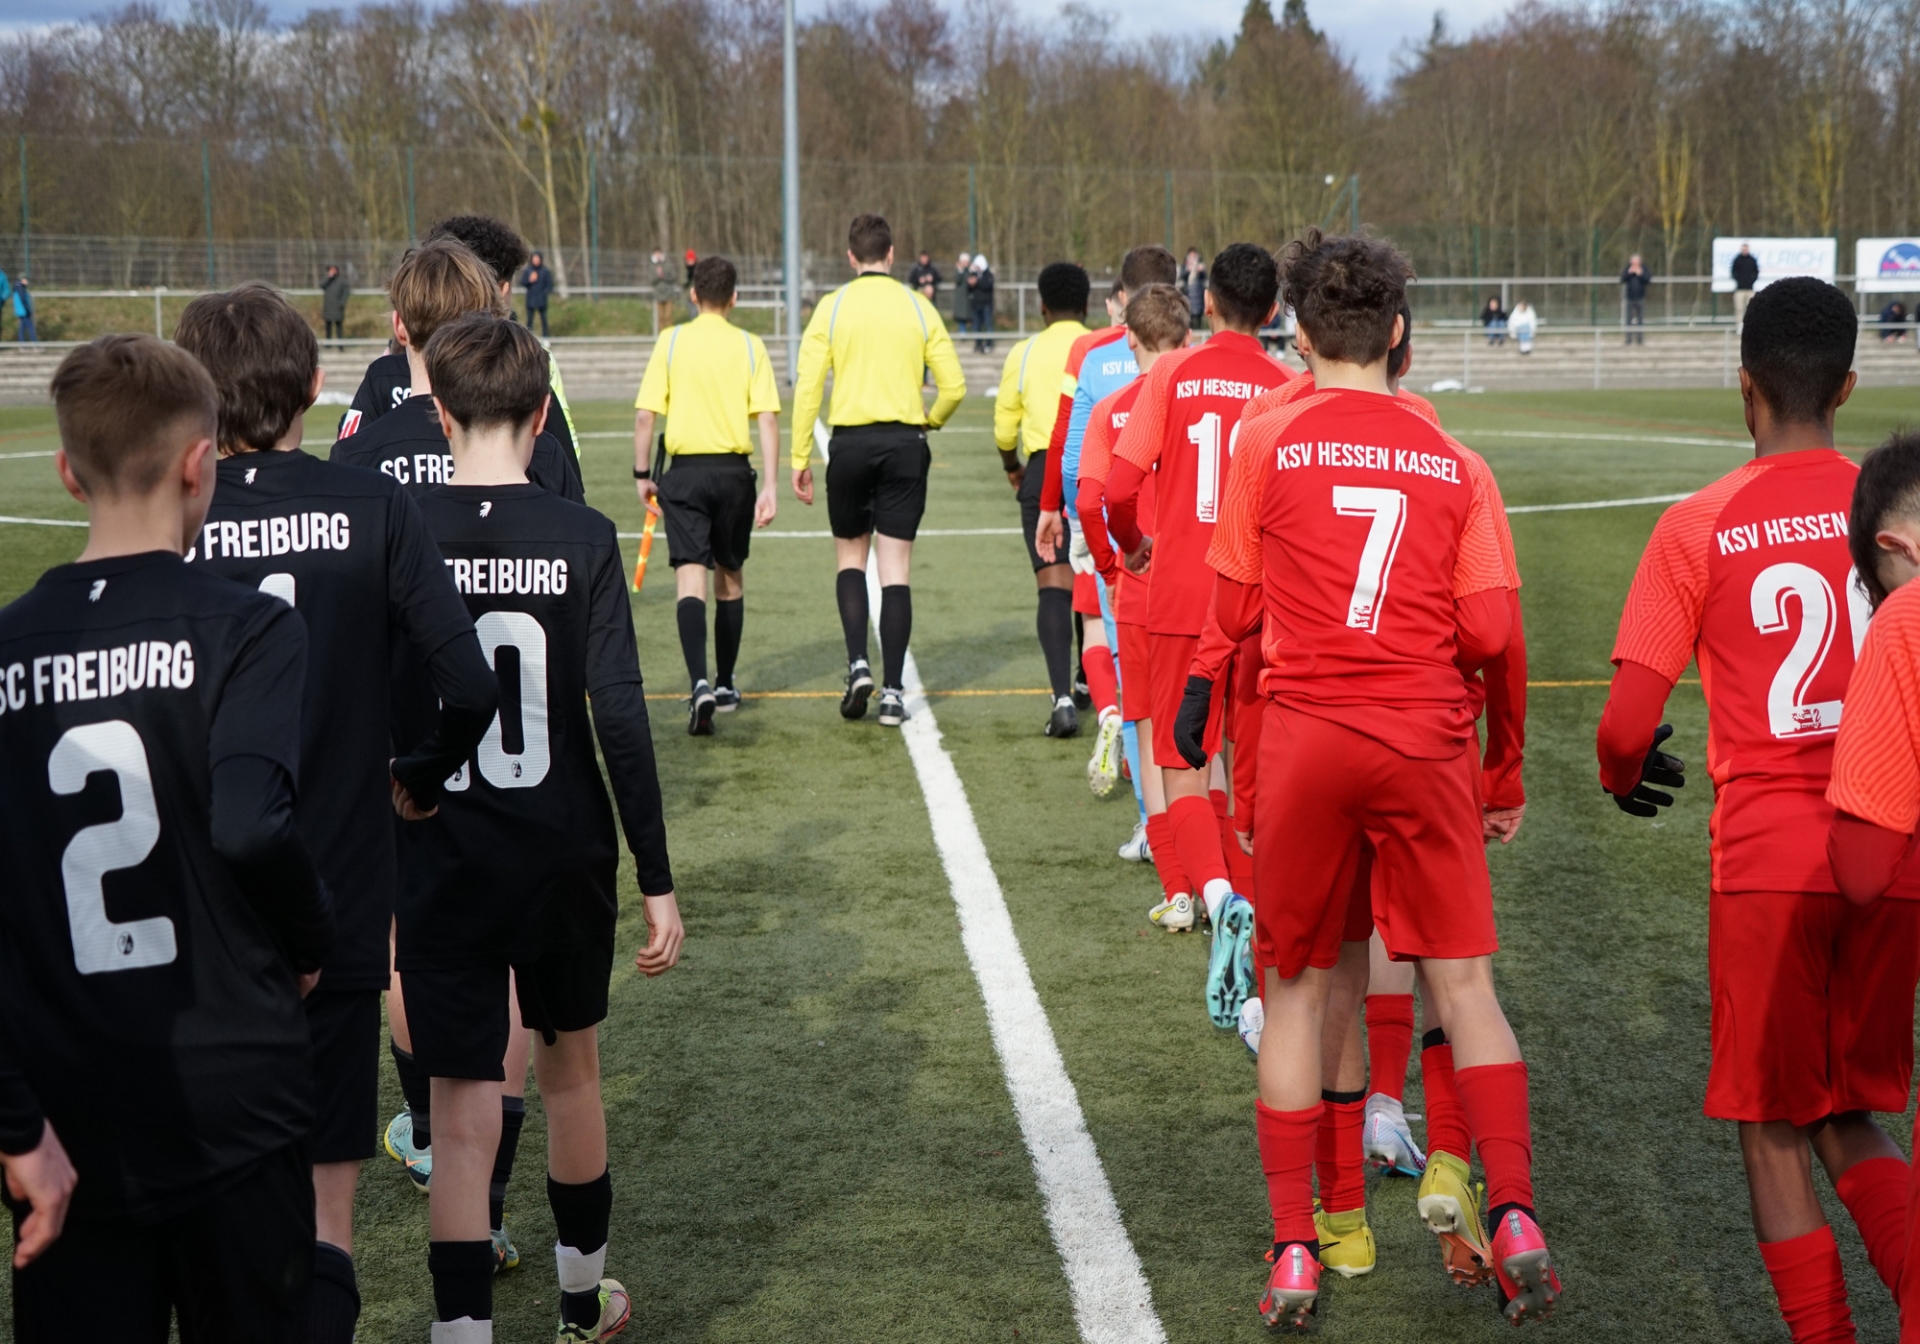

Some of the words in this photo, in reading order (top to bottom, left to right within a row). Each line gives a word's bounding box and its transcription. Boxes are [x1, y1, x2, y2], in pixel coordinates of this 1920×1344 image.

[1102, 360, 1122, 375] KSV
[1124, 359, 1140, 374] HE
[1177, 380, 1200, 399] KSV
[1203, 379, 1251, 399] HESSEN
[1254, 385, 1268, 397] K
[1112, 412, 1130, 428] KS
[1277, 442, 1312, 470] KSV
[1317, 441, 1389, 471] HESSEN
[1395, 449, 1461, 485] KASSEL
[204, 512, 350, 561] FREIBURG
[1716, 523, 1758, 555] KSV
[1764, 511, 1849, 546] HESSEN
[1332, 485, 1407, 635] 7
[33, 640, 195, 705] FREIBURG
[440, 611, 551, 791] 0
[48, 719, 177, 975] 2
